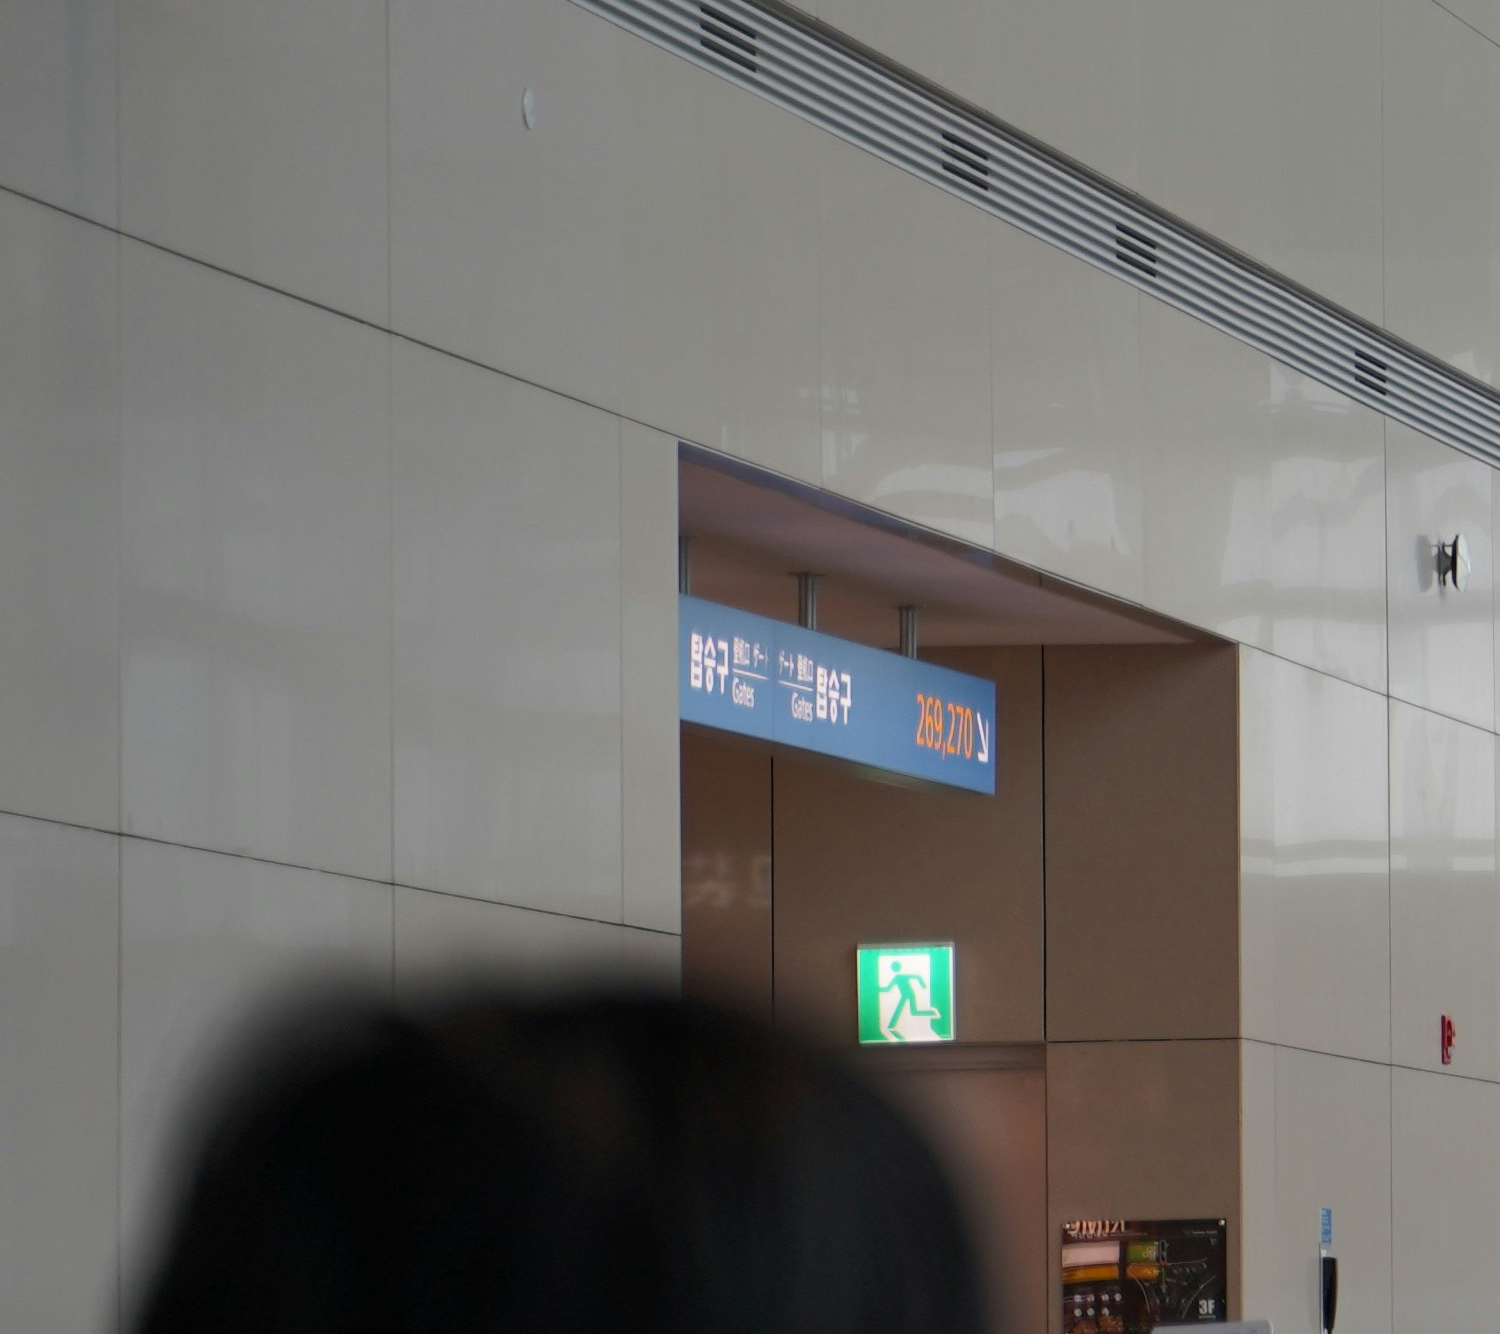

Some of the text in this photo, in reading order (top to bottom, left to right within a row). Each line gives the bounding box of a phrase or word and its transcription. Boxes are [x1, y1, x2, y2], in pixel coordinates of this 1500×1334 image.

[691, 632, 729, 694] 탑승구
[732, 677, 754, 708] Gates
[791, 692, 814, 722] Gates
[816, 665, 852, 726] 탑승구
[915, 693, 973, 760] 269,270
[1199, 1299, 1216, 1315] 3F
